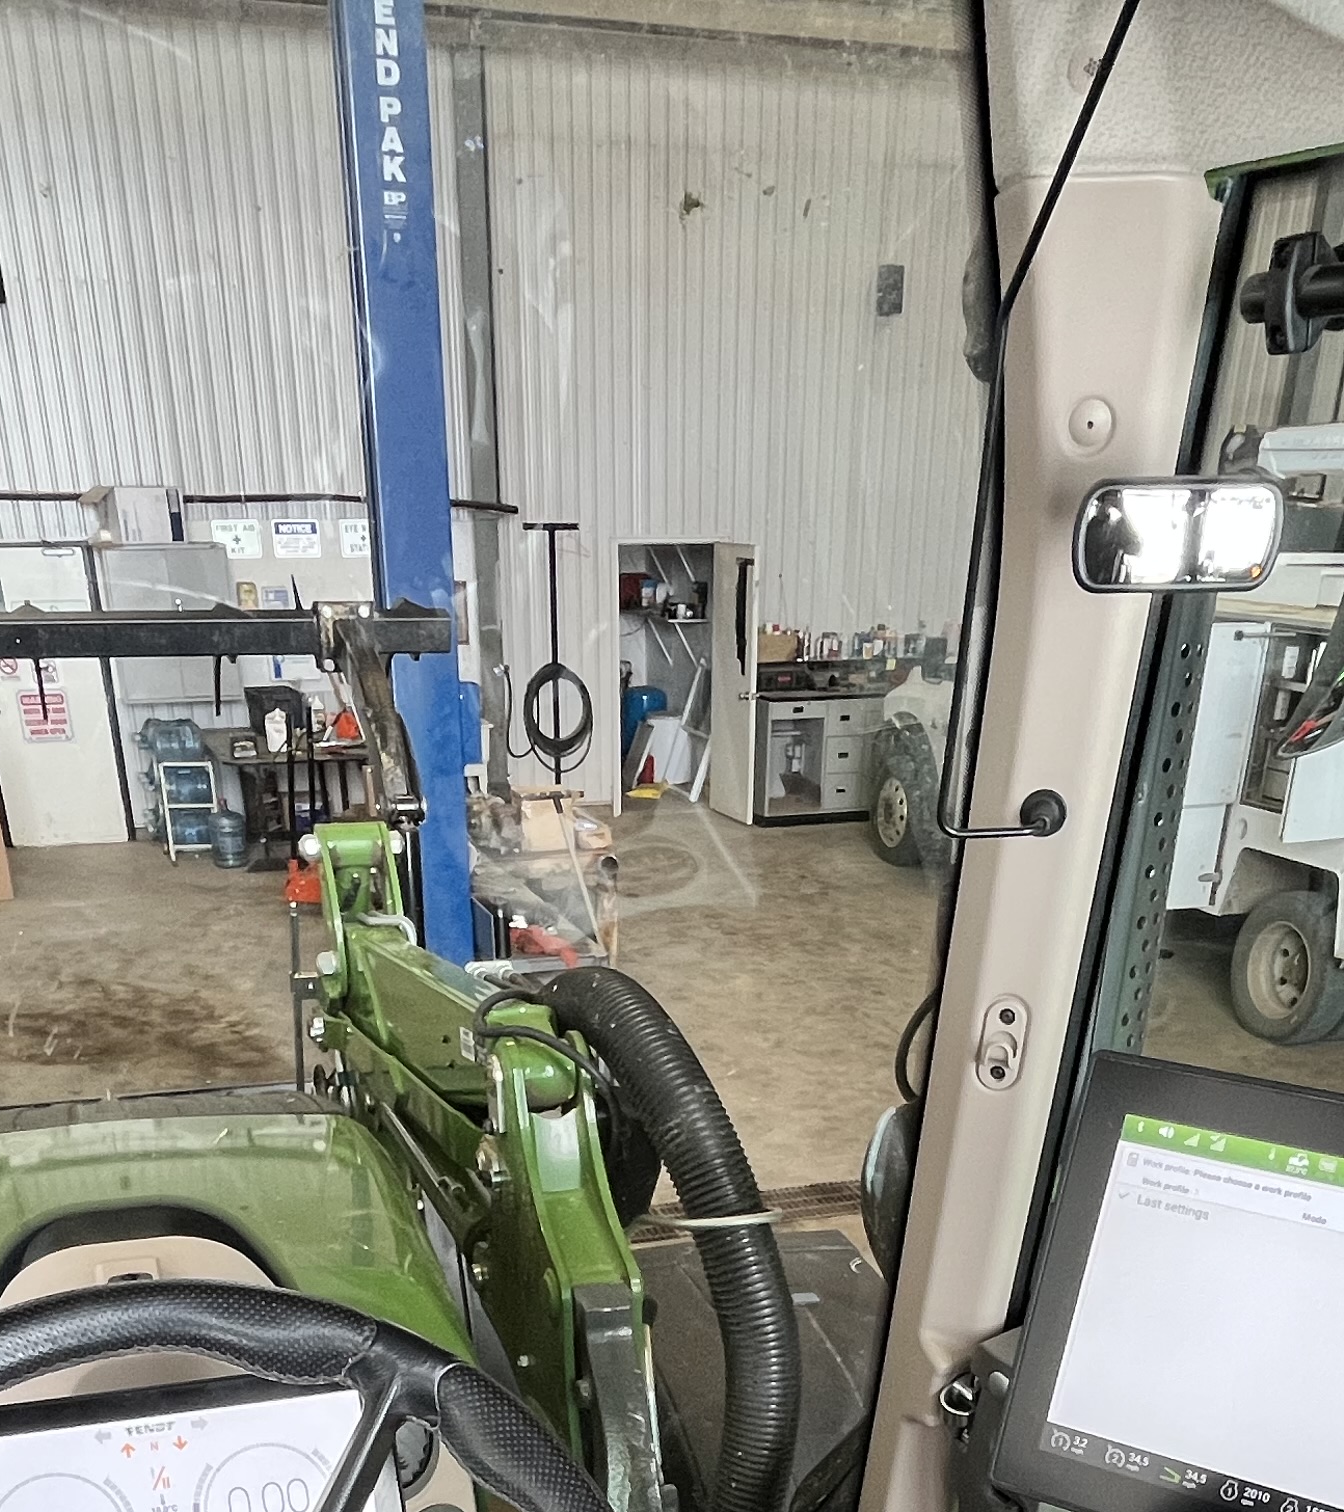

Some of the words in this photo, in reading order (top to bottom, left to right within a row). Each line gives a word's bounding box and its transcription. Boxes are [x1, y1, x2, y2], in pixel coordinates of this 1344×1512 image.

[379, 96, 406, 182] PAK
[215, 524, 238, 532] FIRST
[242, 523, 255, 532] AID
[278, 523, 313, 534] NOTICE
[1136, 1194, 1163, 1208] Last
[1164, 1200, 1209, 1221] settings
[125, 1421, 176, 1436] FENDT
[150, 1441, 159, 1451] N
[1242, 1486, 1271, 1503] 2010
